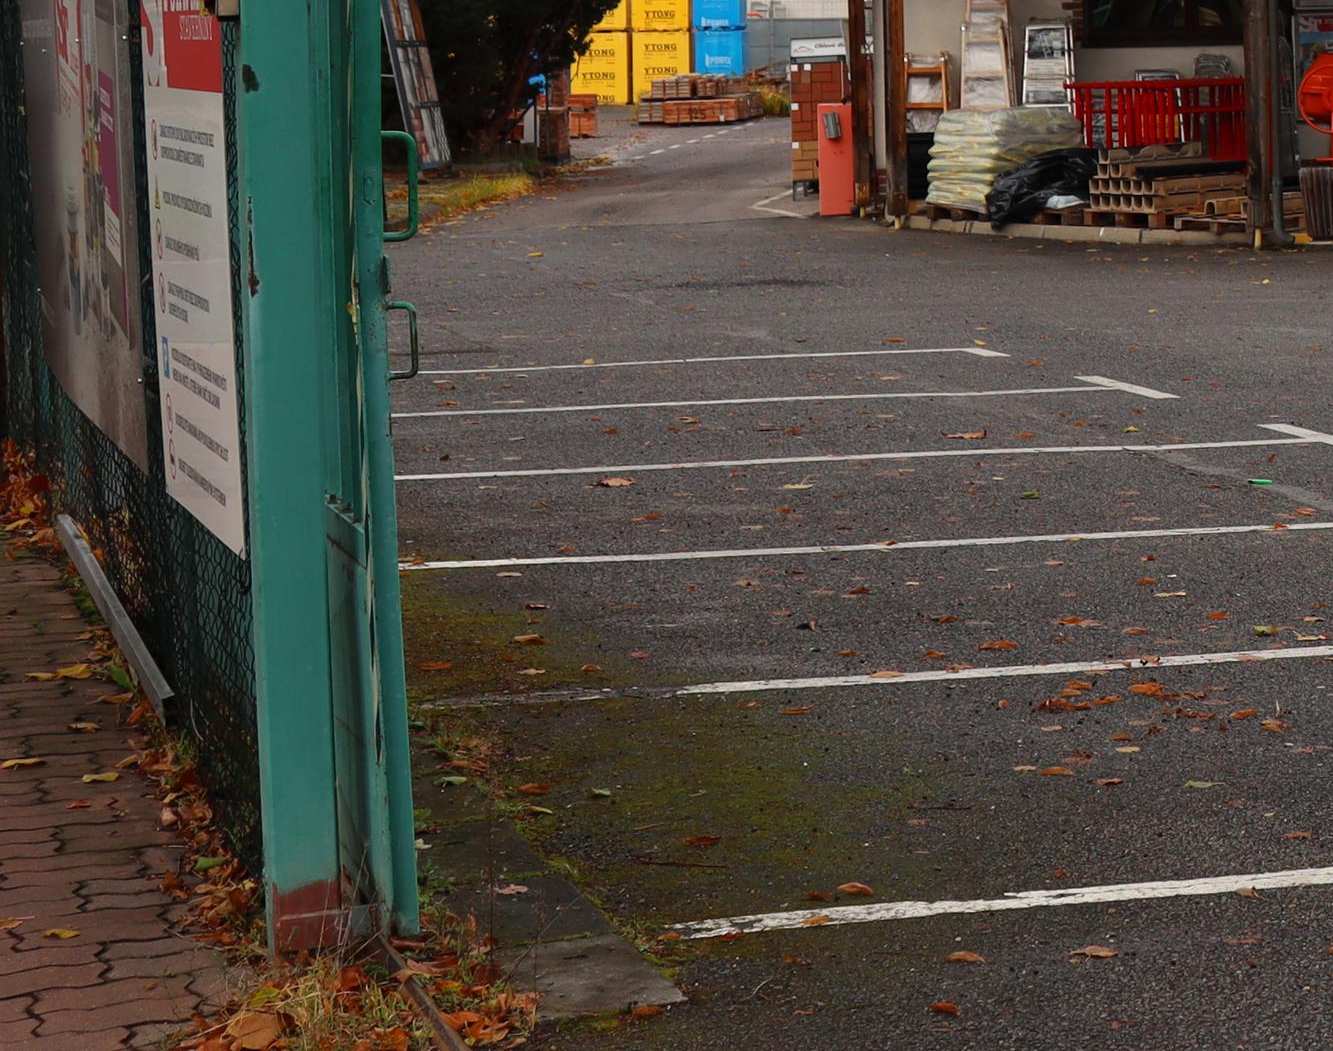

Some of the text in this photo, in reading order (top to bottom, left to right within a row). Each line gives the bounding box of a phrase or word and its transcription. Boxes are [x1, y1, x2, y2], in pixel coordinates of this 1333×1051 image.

[644, 10, 676, 20] YTONG
[644, 43, 677, 52] YTONG
[644, 66, 677, 75] YTONG
[581, 71, 616, 80] YTONG
